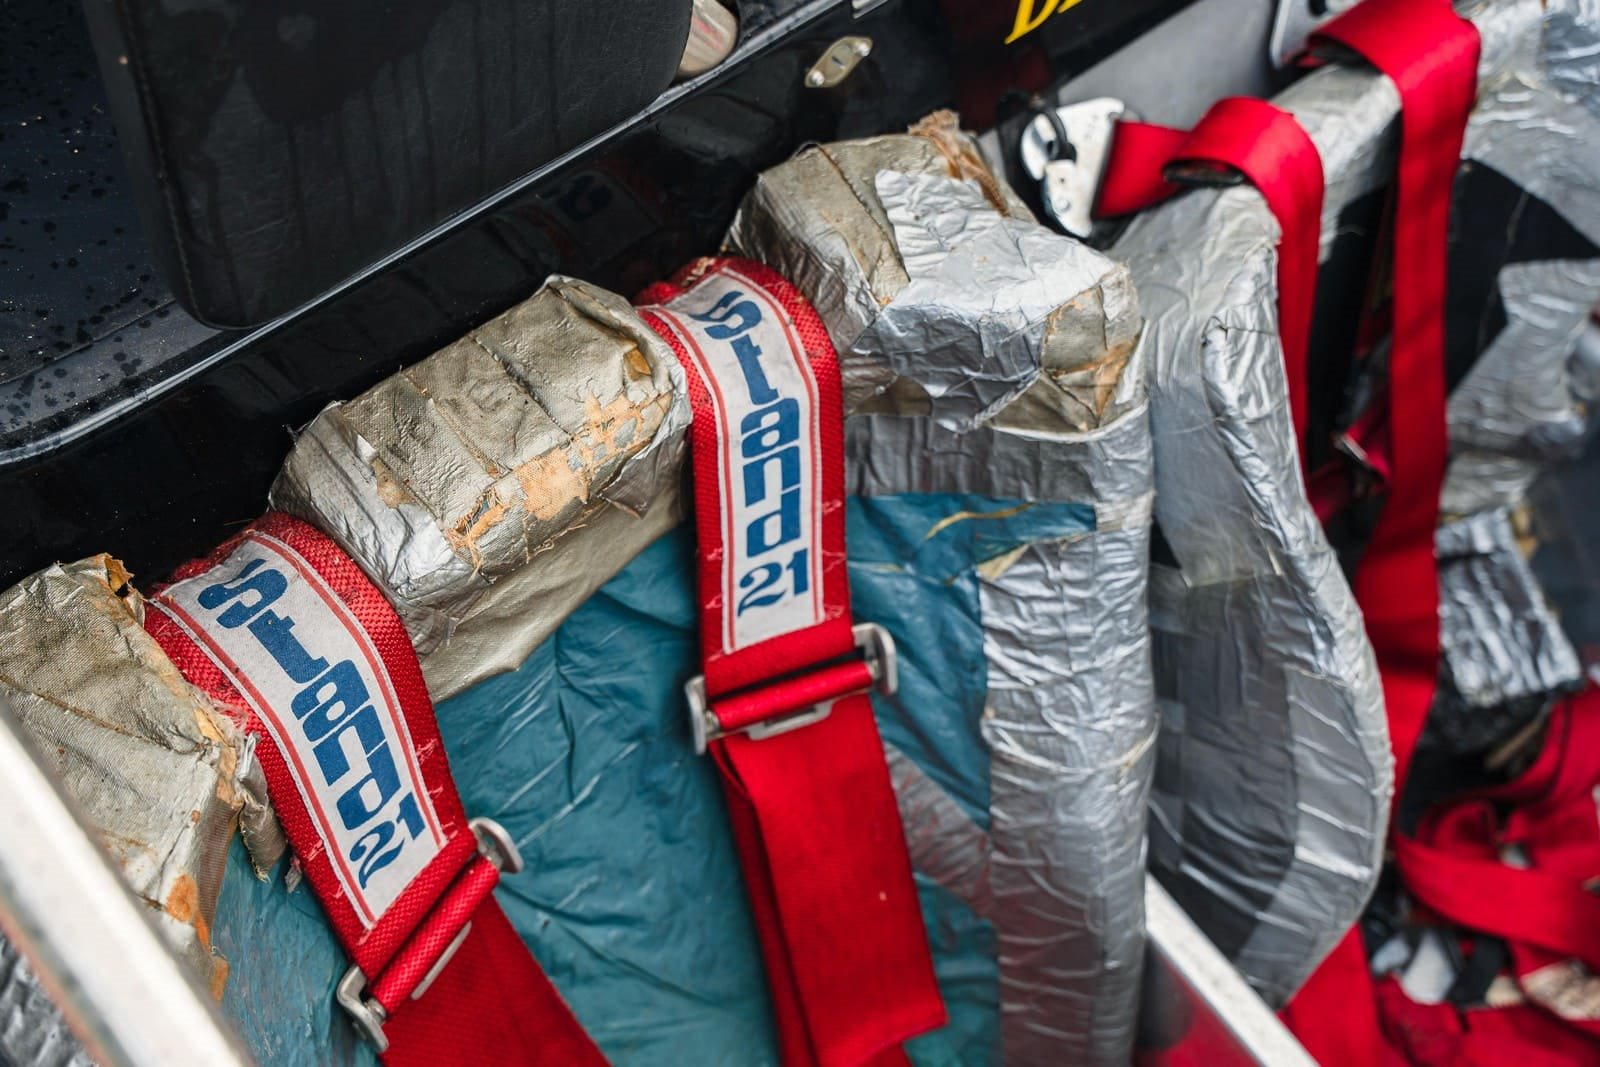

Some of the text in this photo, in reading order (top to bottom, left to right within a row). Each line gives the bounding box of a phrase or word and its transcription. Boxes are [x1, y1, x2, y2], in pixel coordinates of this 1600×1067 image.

[688, 290, 809, 618] Stand 21
[197, 558, 426, 890] Stand 21
